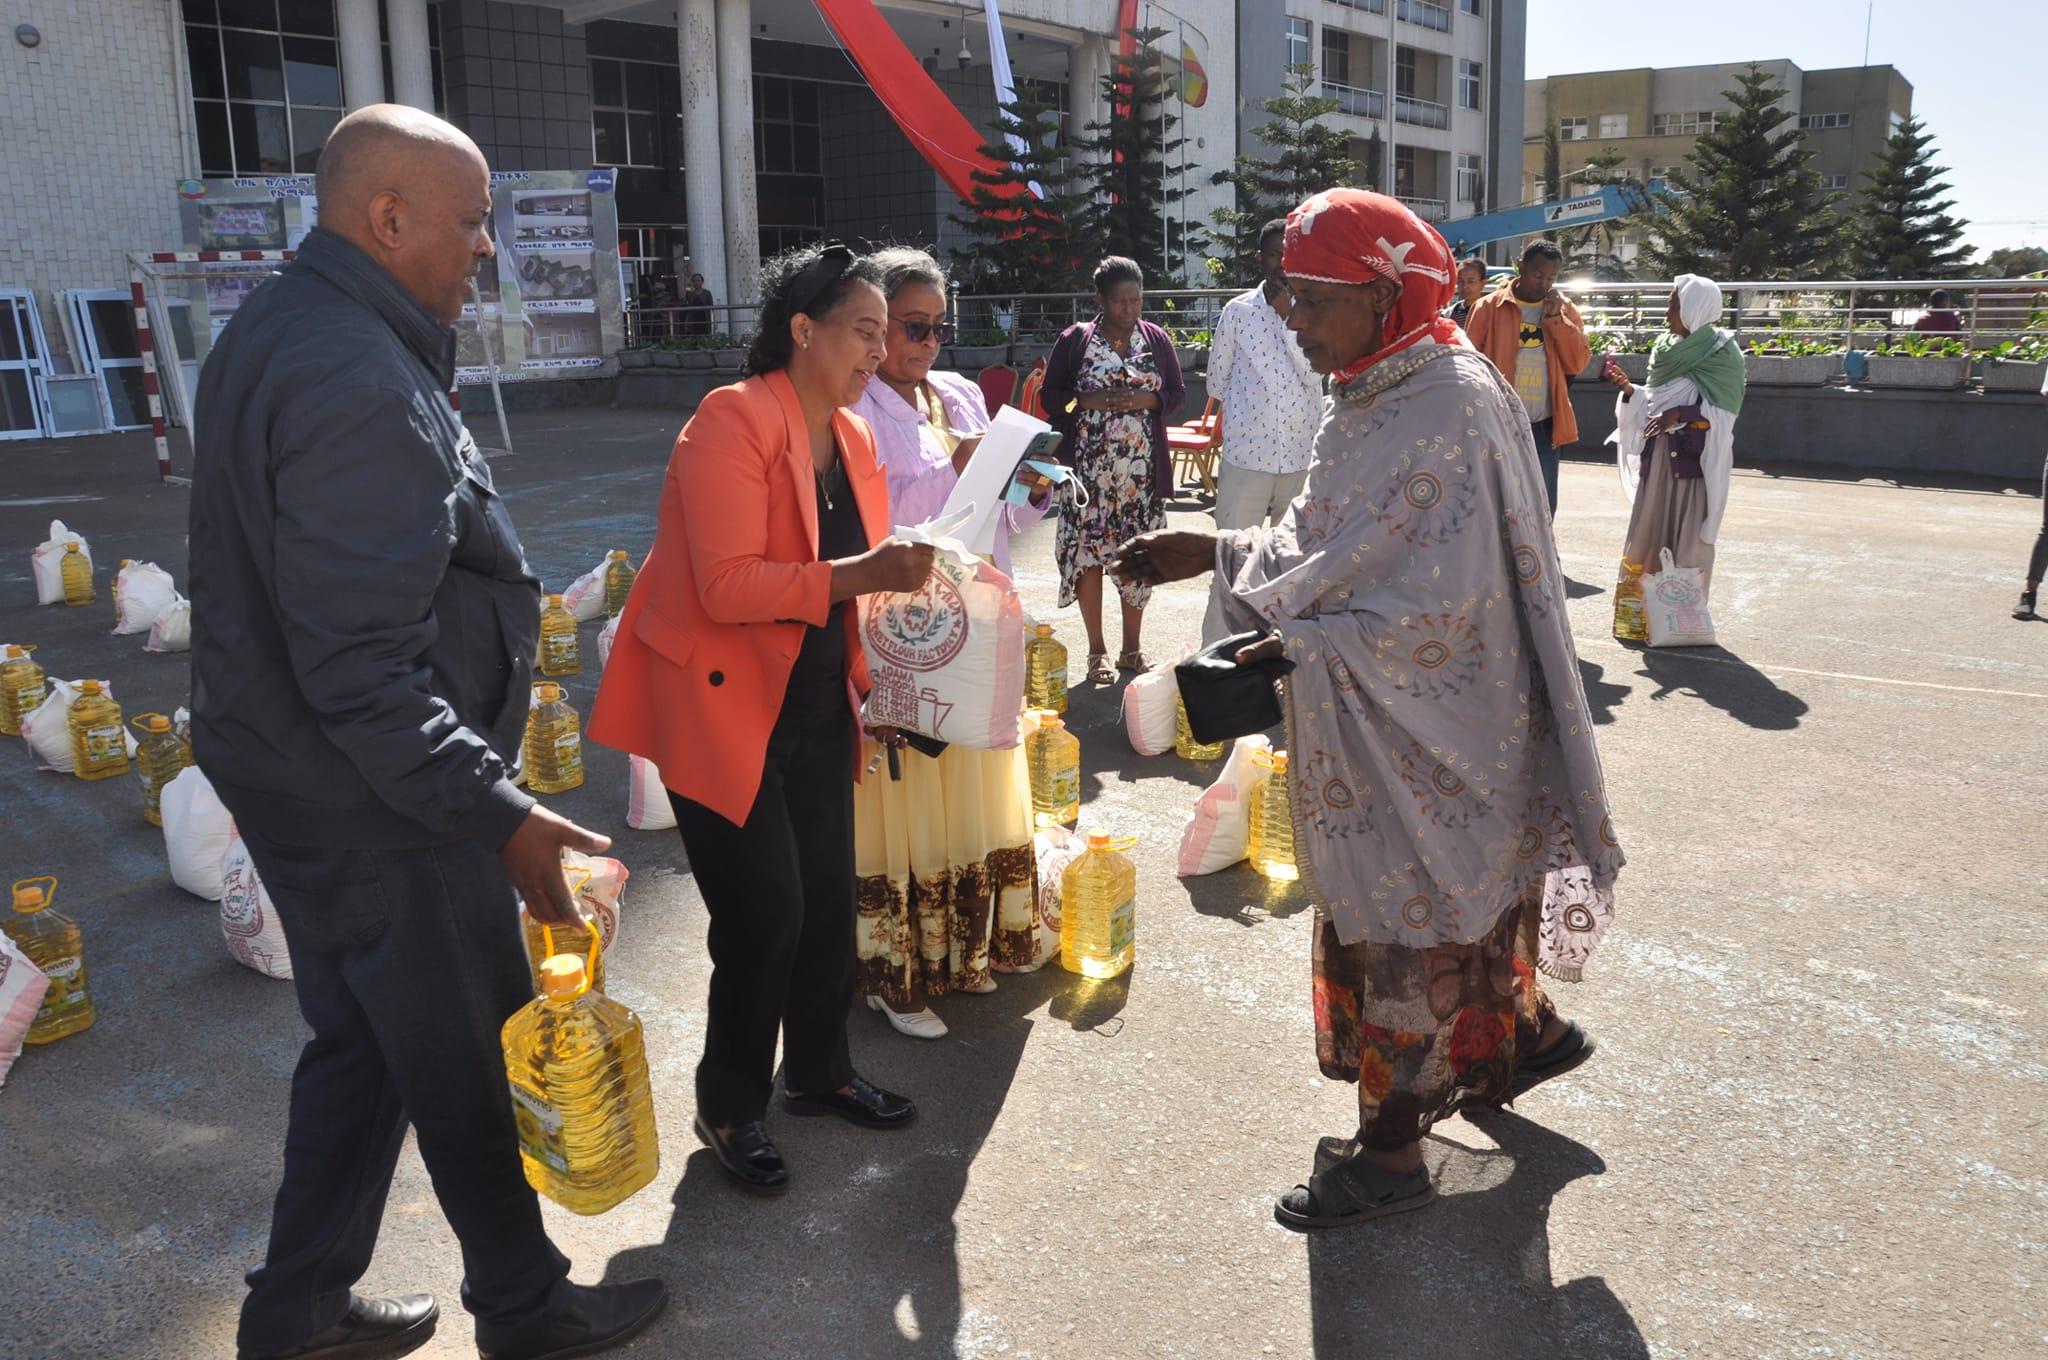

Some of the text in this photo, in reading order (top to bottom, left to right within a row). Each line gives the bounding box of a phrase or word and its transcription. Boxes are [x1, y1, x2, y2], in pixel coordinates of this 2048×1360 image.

[1567, 198, 1603, 212] TADANO
[887, 641, 917, 660] FLOUR
[917, 630, 959, 661] FACTORY
[880, 665, 915, 683] ADAMA
